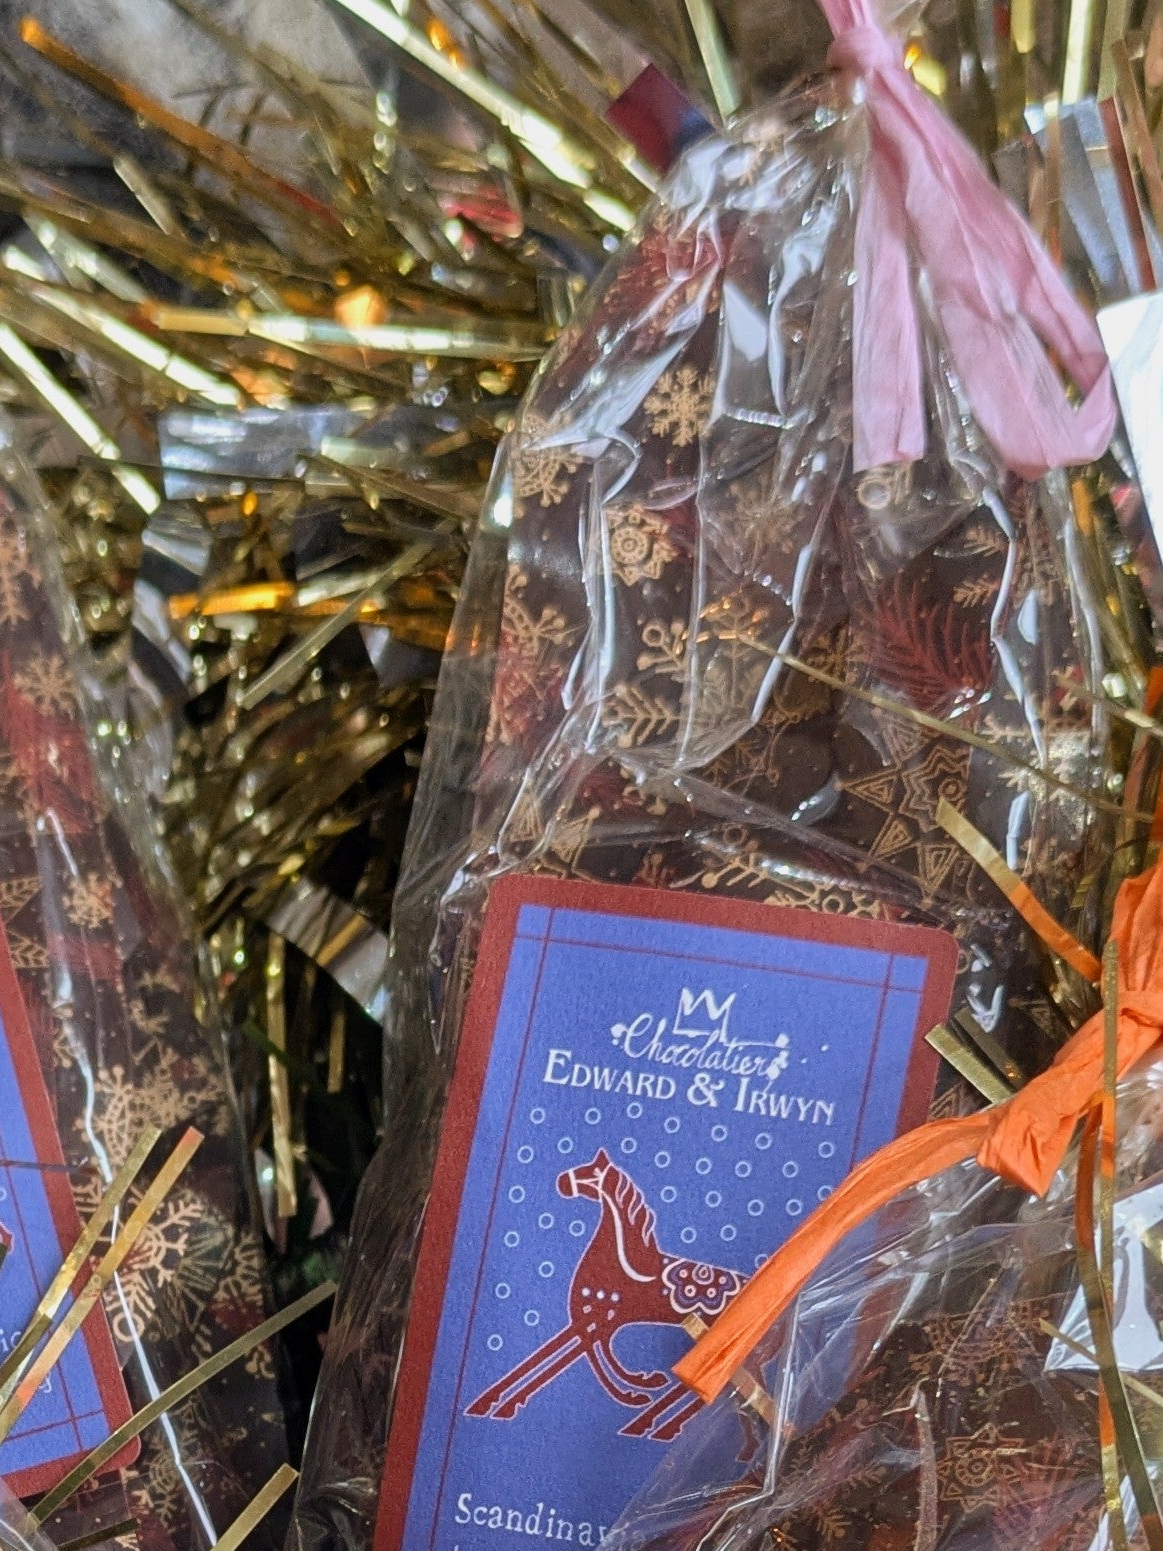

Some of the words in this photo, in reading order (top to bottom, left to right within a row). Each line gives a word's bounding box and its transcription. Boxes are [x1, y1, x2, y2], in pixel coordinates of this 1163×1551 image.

[542, 1048, 677, 1100] EDWARD
[686, 1071, 725, 1108] &
[733, 1077, 836, 1126] IRWYN
[454, 1492, 612, 1547] Scandinav
